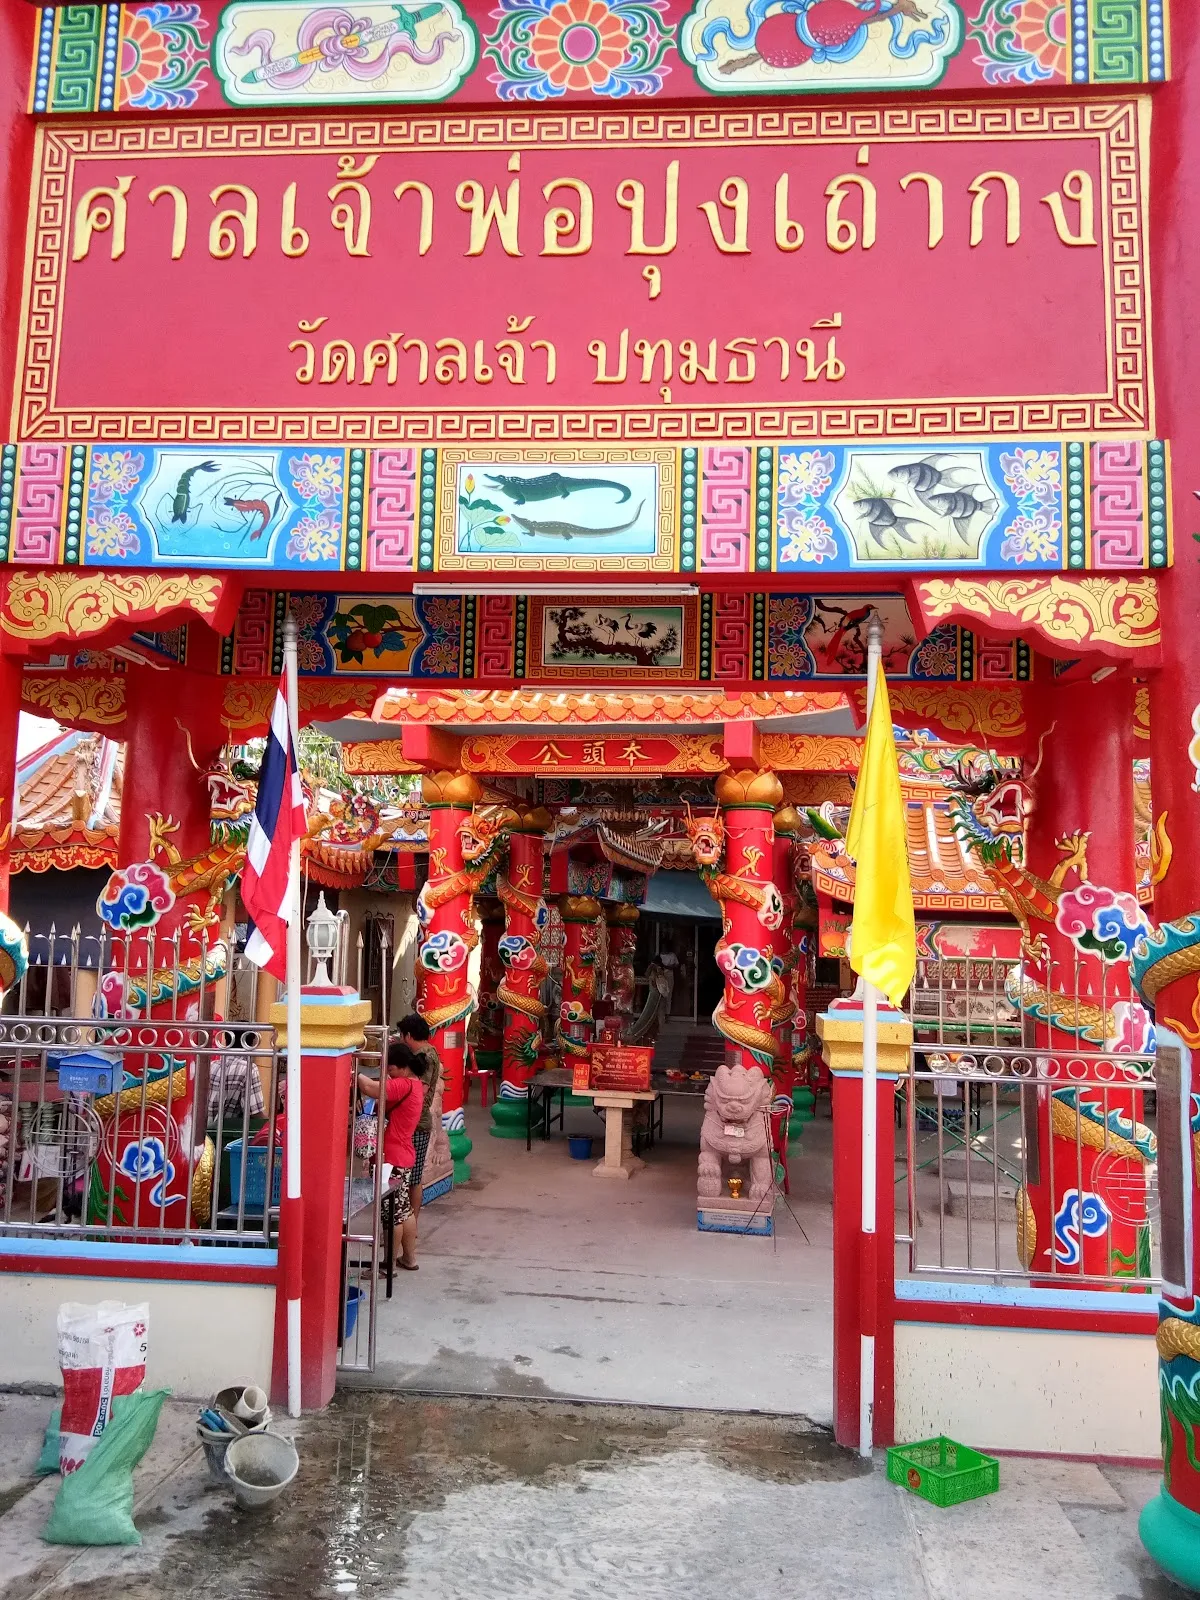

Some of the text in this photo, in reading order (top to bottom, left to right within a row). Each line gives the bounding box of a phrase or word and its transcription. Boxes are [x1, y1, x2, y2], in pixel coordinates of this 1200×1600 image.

[71, 145, 1098, 300] ศาลเจ้าพ่อปุงเถ่ากง
[288, 312, 846, 404] วัดศาลเจ้า ปทุมธานี
